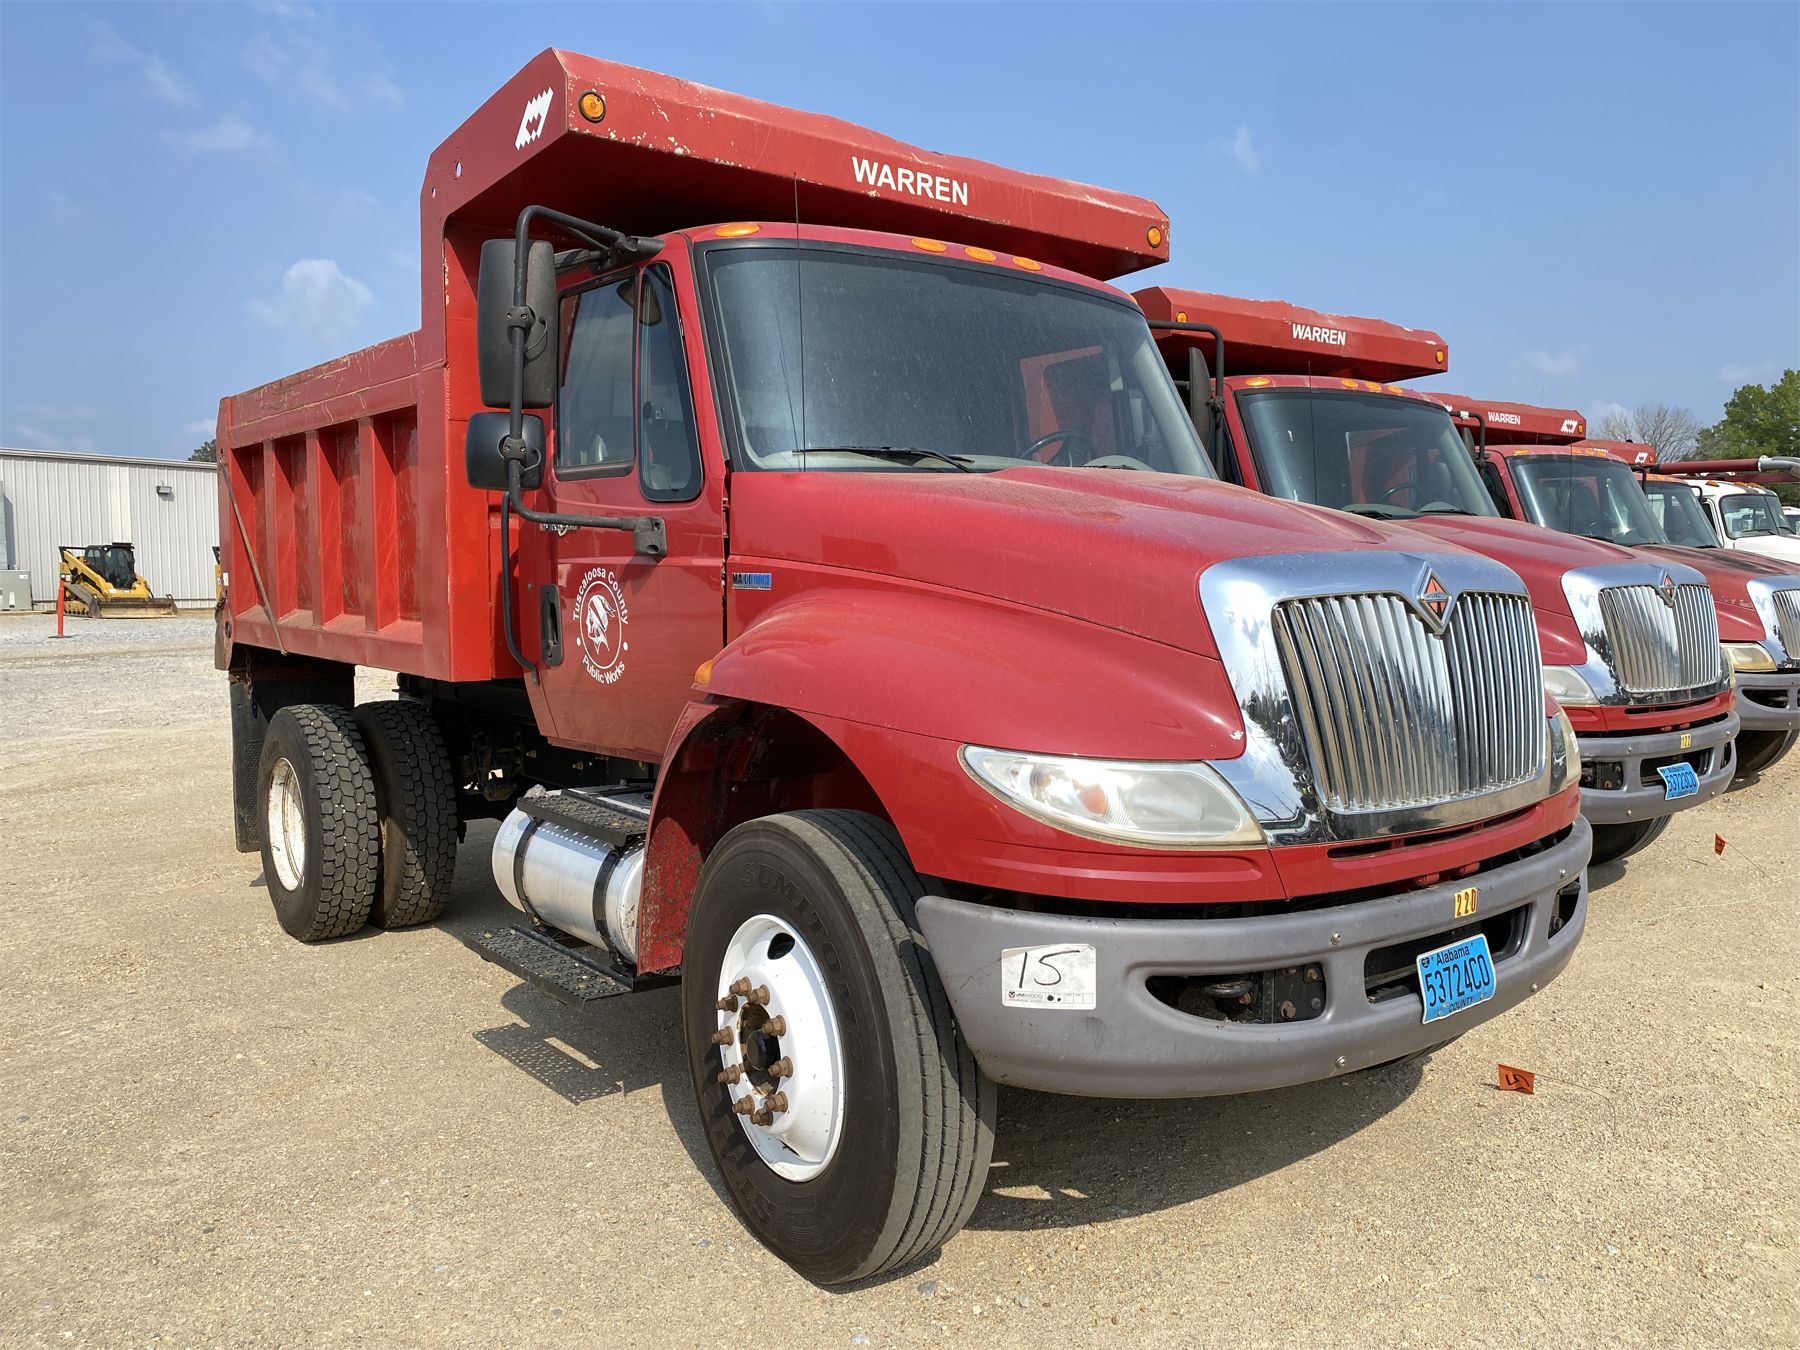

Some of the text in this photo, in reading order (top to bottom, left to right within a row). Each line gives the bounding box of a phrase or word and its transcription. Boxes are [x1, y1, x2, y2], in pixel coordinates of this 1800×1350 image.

[852, 156, 967, 206] WARREN
[1292, 323, 1346, 346] WARREN
[1487, 411, 1520, 425] WARREN
[573, 567, 629, 625] Tuscaloosa County
[583, 654, 625, 684] Public Works
[1456, 889, 1477, 917] 220
[738, 862, 865, 1070] SUMITOMO
[1019, 950, 1081, 989] 15
[1436, 945, 1470, 967] Alabama
